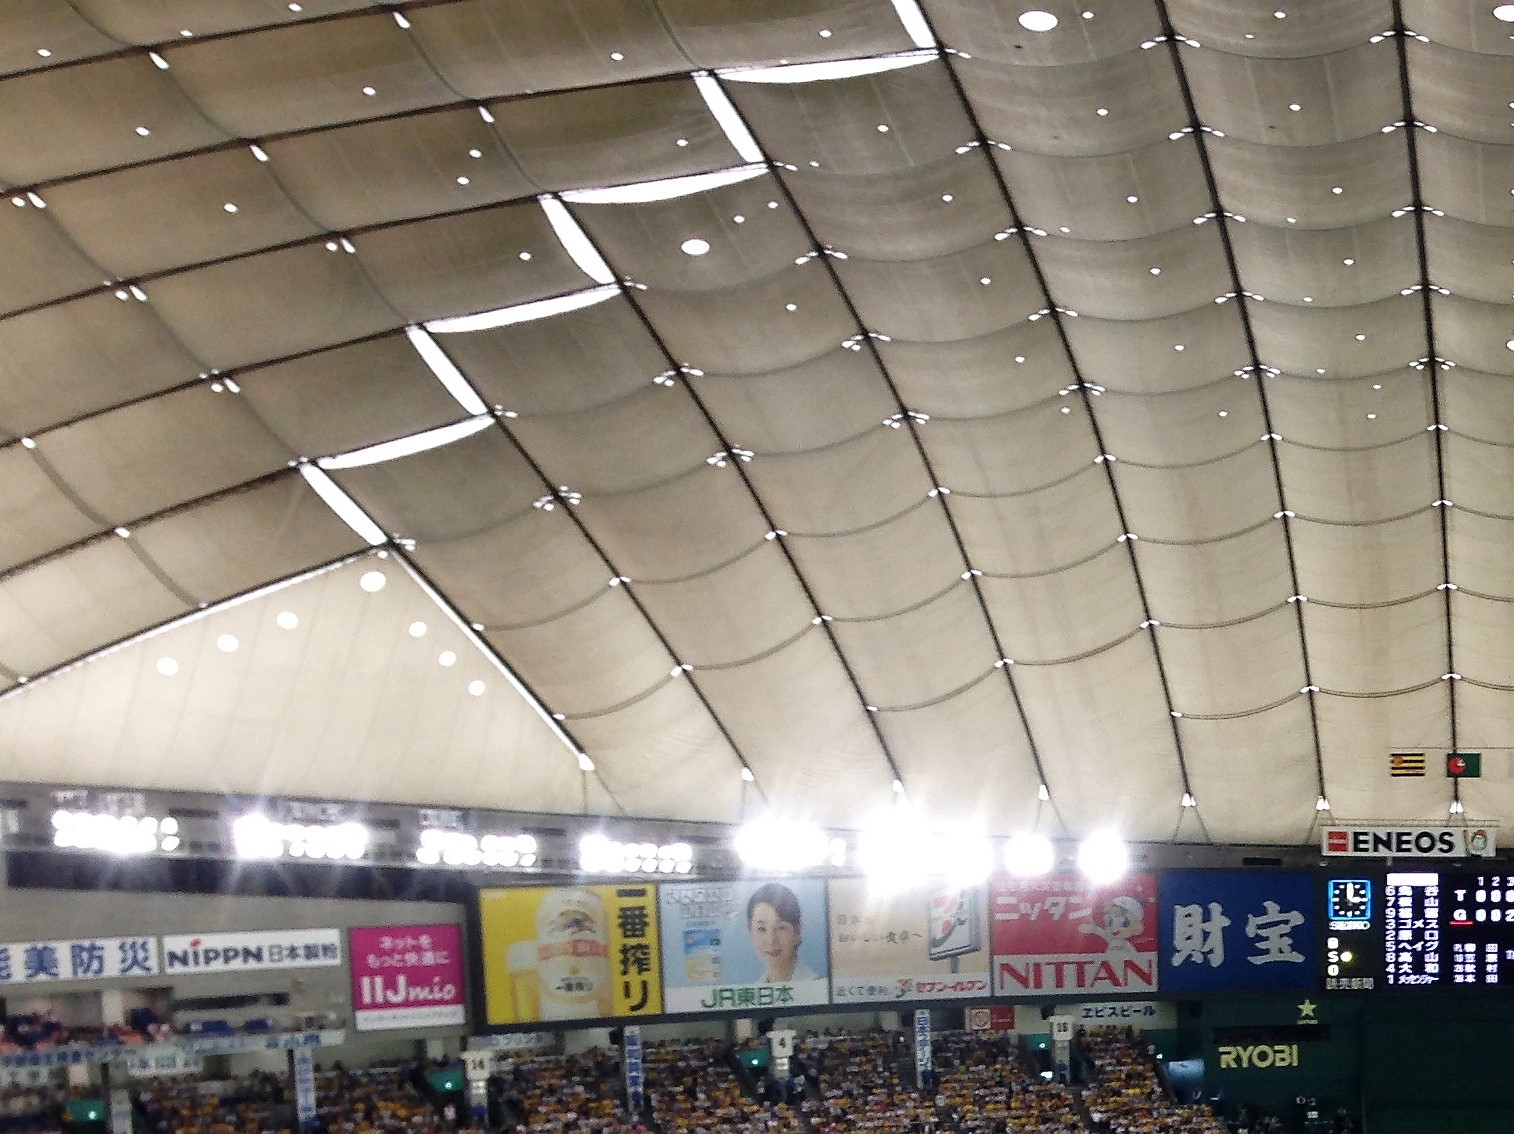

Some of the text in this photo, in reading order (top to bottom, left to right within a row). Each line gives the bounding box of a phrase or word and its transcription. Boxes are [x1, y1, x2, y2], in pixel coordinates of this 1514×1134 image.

[1353, 831, 1455, 854] ENEOS
[1476, 876, 1486, 888] 1
[1490, 875, 1501, 887] 2
[1385, 885, 1396, 897] 6
[1453, 889, 1467, 902] T
[1475, 889, 1487, 903] 0
[1490, 889, 1502, 903] 0
[1385, 896, 1396, 907] 7
[994, 896, 1093, 921] ニッタン
[1385, 907, 1396, 919] 9
[1453, 908, 1467, 921] G
[1475, 908, 1487, 922] 0
[1490, 908, 1502, 922] 0
[1385, 919, 1396, 929] 3
[1171, 900, 1306, 967] 財宝
[1385, 929, 1396, 941] 2
[616, 888, 651, 1011] 一番搾り
[1385, 941, 1396, 952] 5
[1327, 951, 1339, 963] S
[1385, 951, 1396, 963] 8
[1000, 958, 1154, 990] NITTAN
[1385, 963, 1396, 974] 4
[1385, 974, 1396, 985] 1
[701, 985, 794, 1009] JR東日本
[1082, 1006, 1156, 1019] エビスビール
[1218, 1044, 1299, 1069] RYOBI
